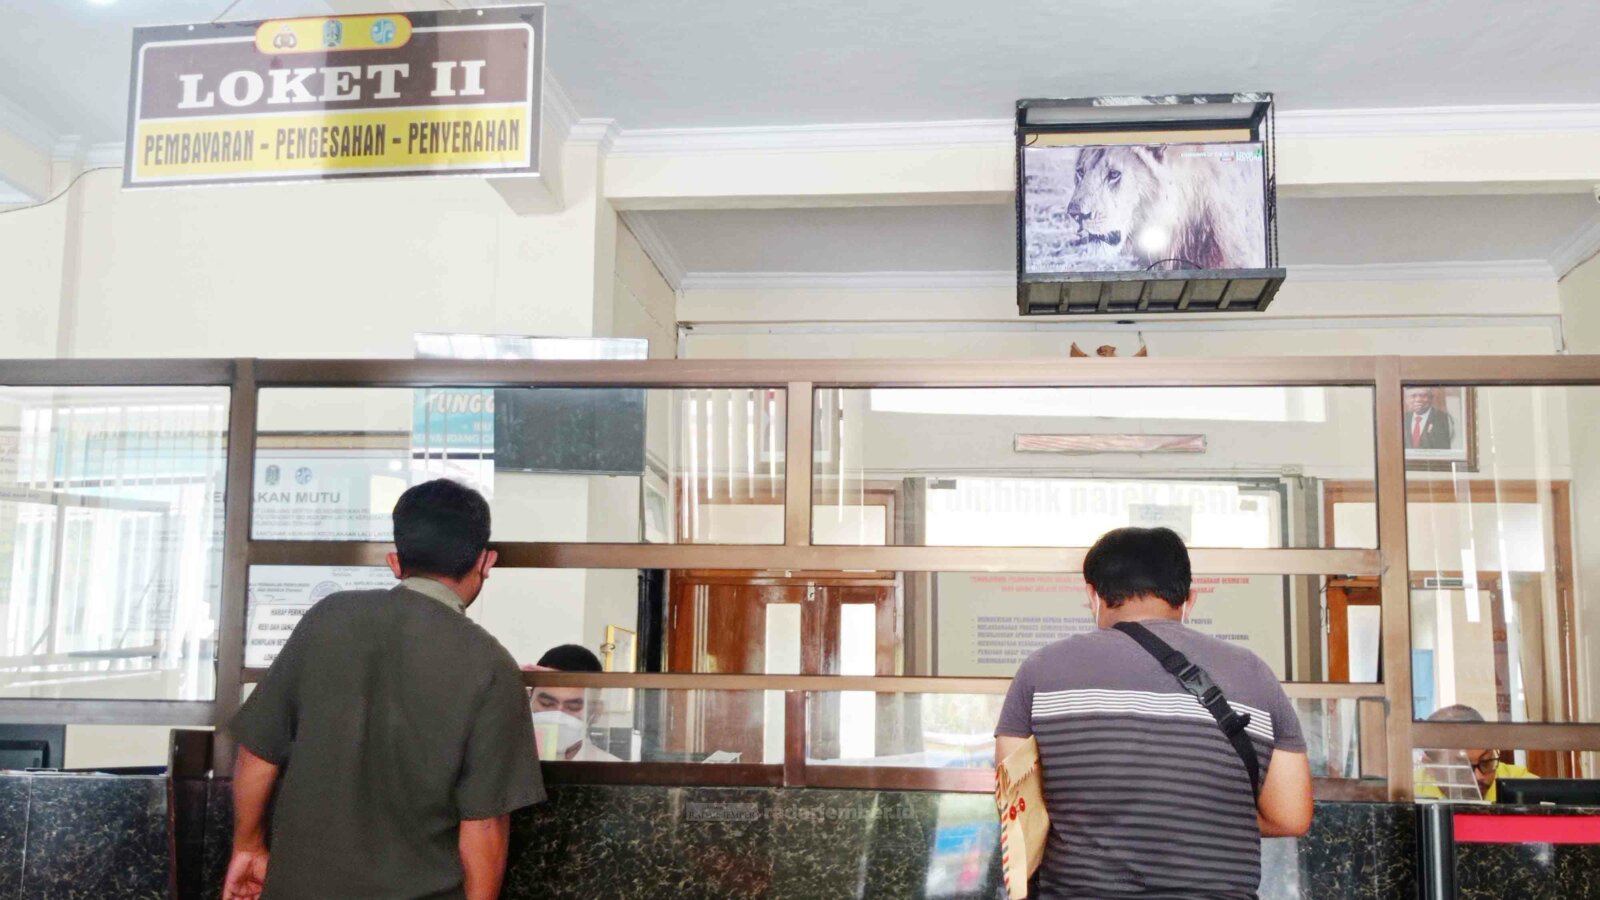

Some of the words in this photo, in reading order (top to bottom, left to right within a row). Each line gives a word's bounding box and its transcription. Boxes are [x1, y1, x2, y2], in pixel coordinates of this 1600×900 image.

[178, 64, 409, 109] LOKET
[431, 59, 486, 98] II
[143, 130, 254, 166] PEMBAYARAN
[275, 124, 386, 160] PENGESAHAN
[408, 119, 520, 156] PENYERAHAN
[425, 392, 494, 414] TUNGG
[295, 491, 341, 503] MUTU
